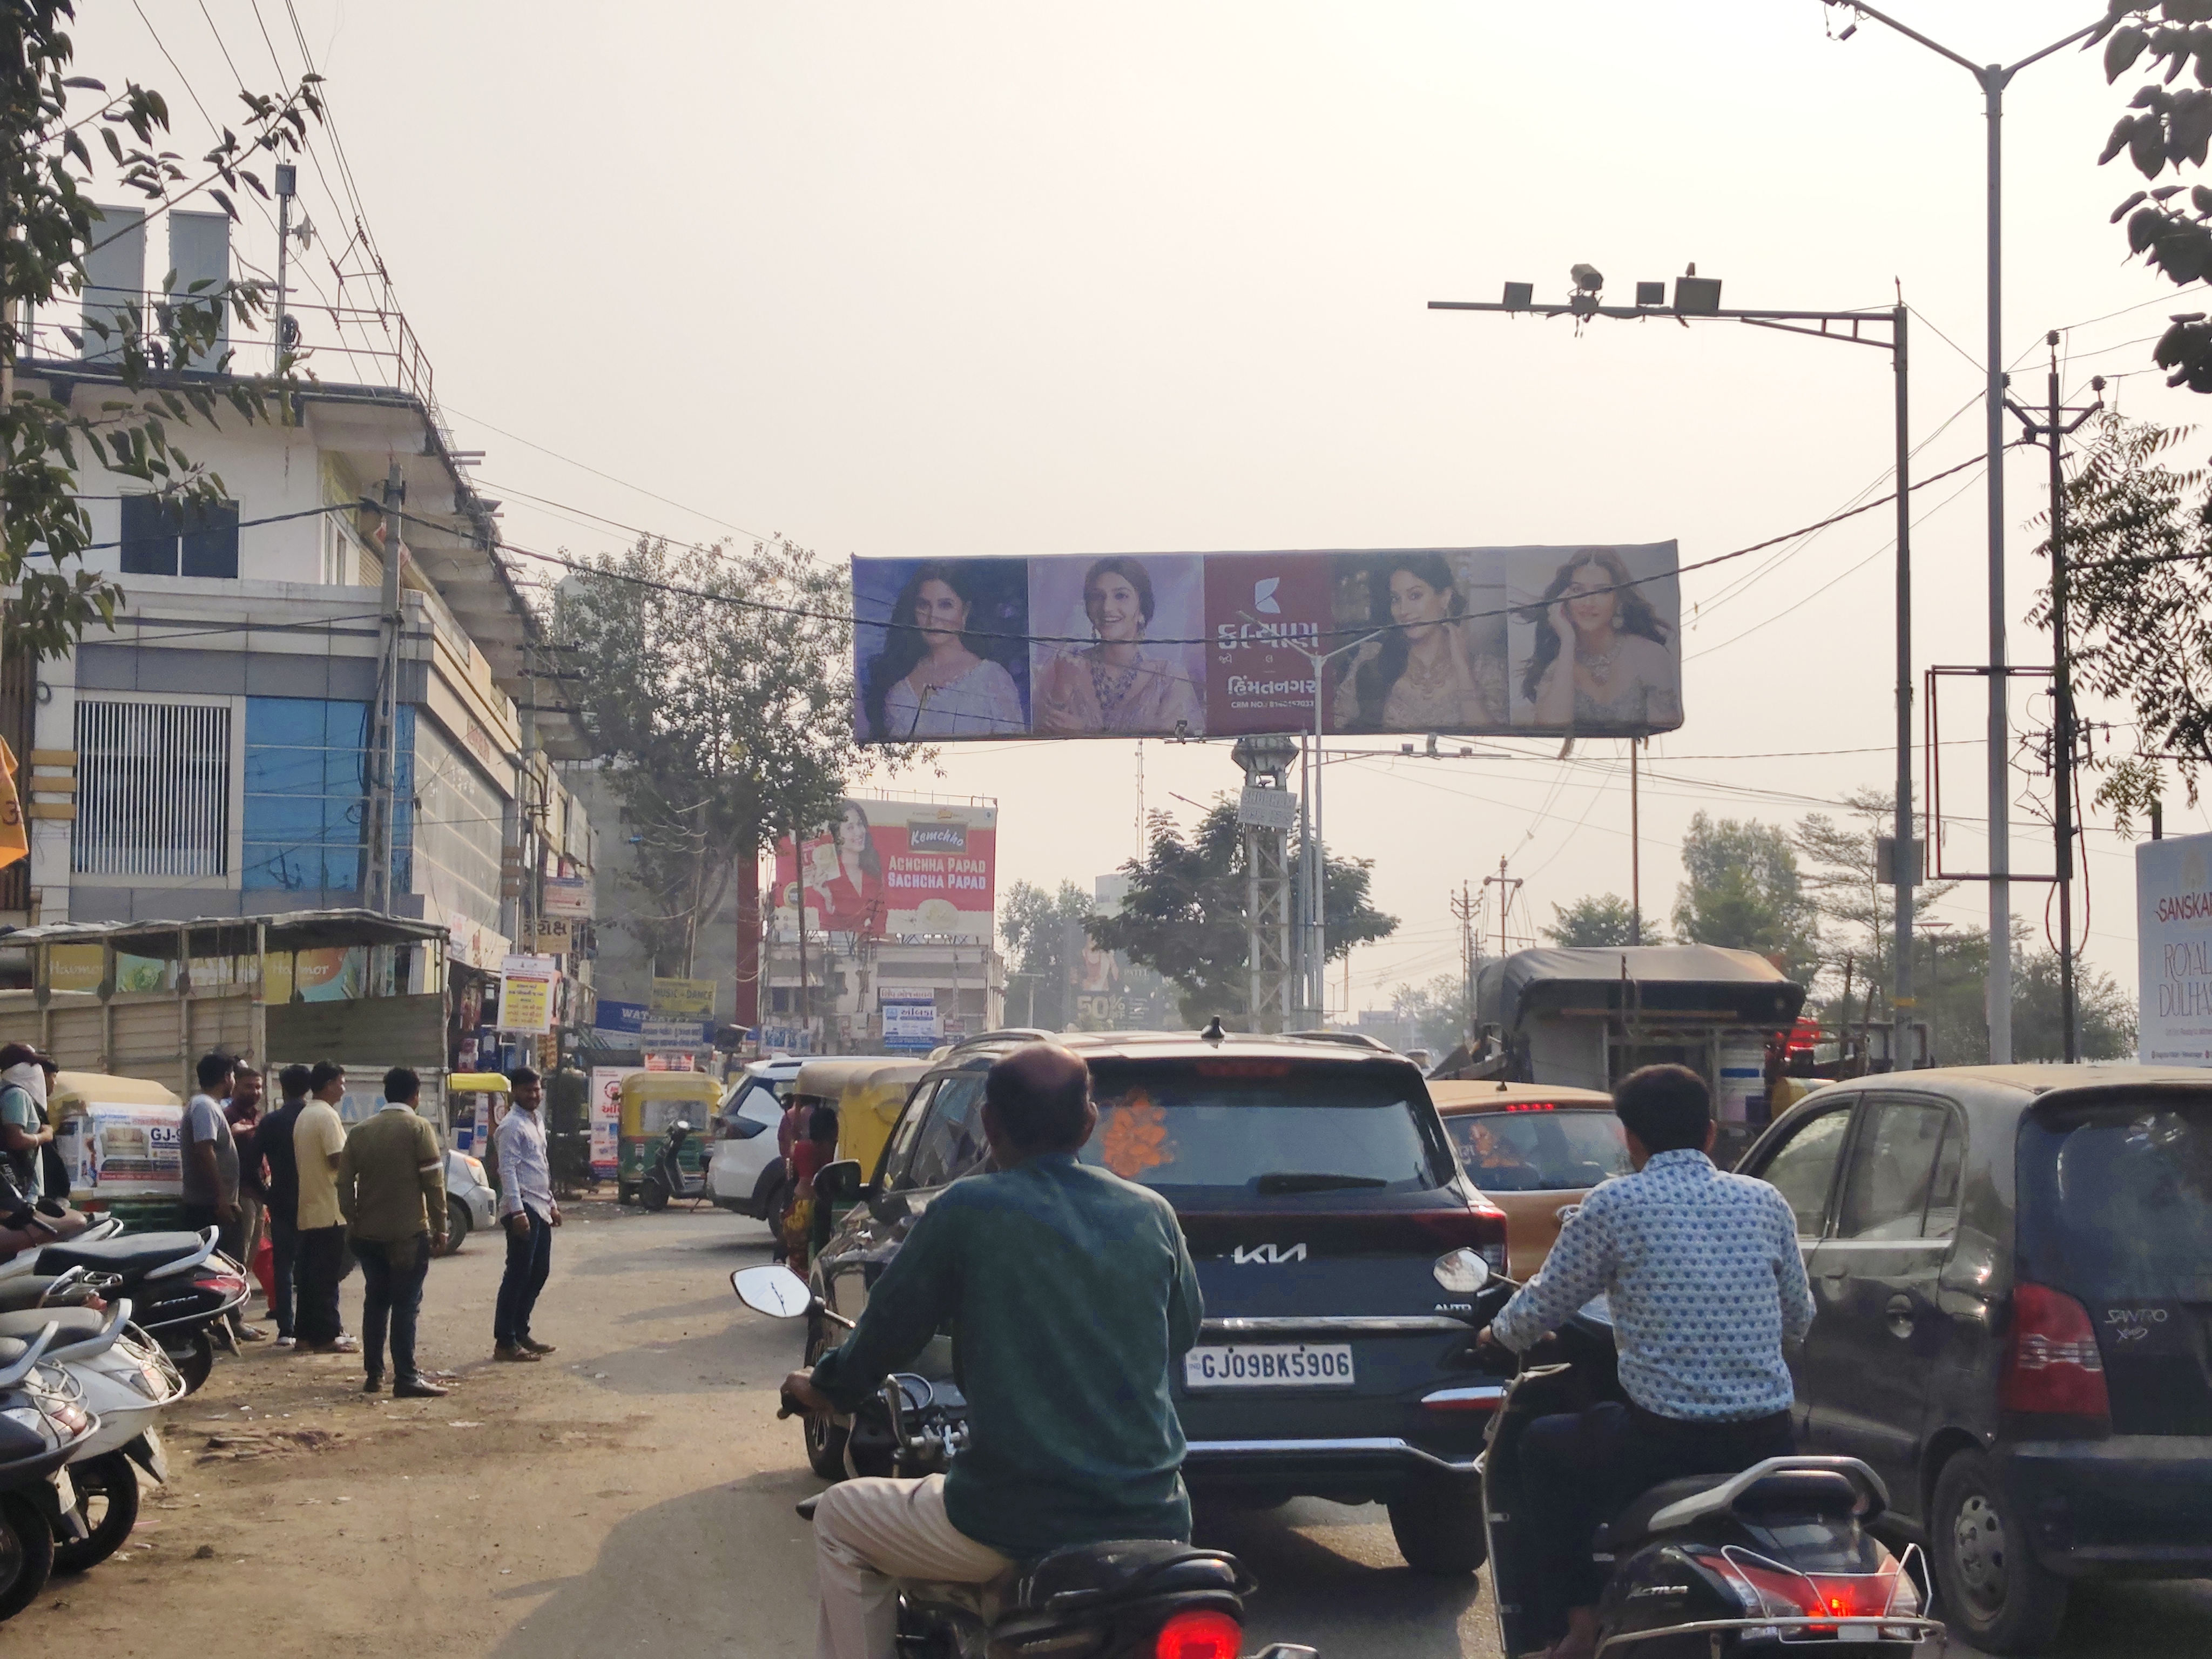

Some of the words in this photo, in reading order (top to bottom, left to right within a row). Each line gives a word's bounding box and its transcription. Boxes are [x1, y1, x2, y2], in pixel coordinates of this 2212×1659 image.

[1227, 675, 1316, 696] હિંમતનગર
[888, 855, 945, 872] ACHCHHA
[947, 857, 986, 873] PAPAD
[888, 872, 945, 888] SACHCHA
[947, 874, 986, 890] PAPAD
[271, 960, 330, 976] Hamor
[2164, 941, 2212, 983] ROYAL
[2159, 981, 2212, 1017] DULHA
[1234, 1243, 1307, 1264] KIA
[1202, 1352, 1350, 1378] GJ09BK5906
